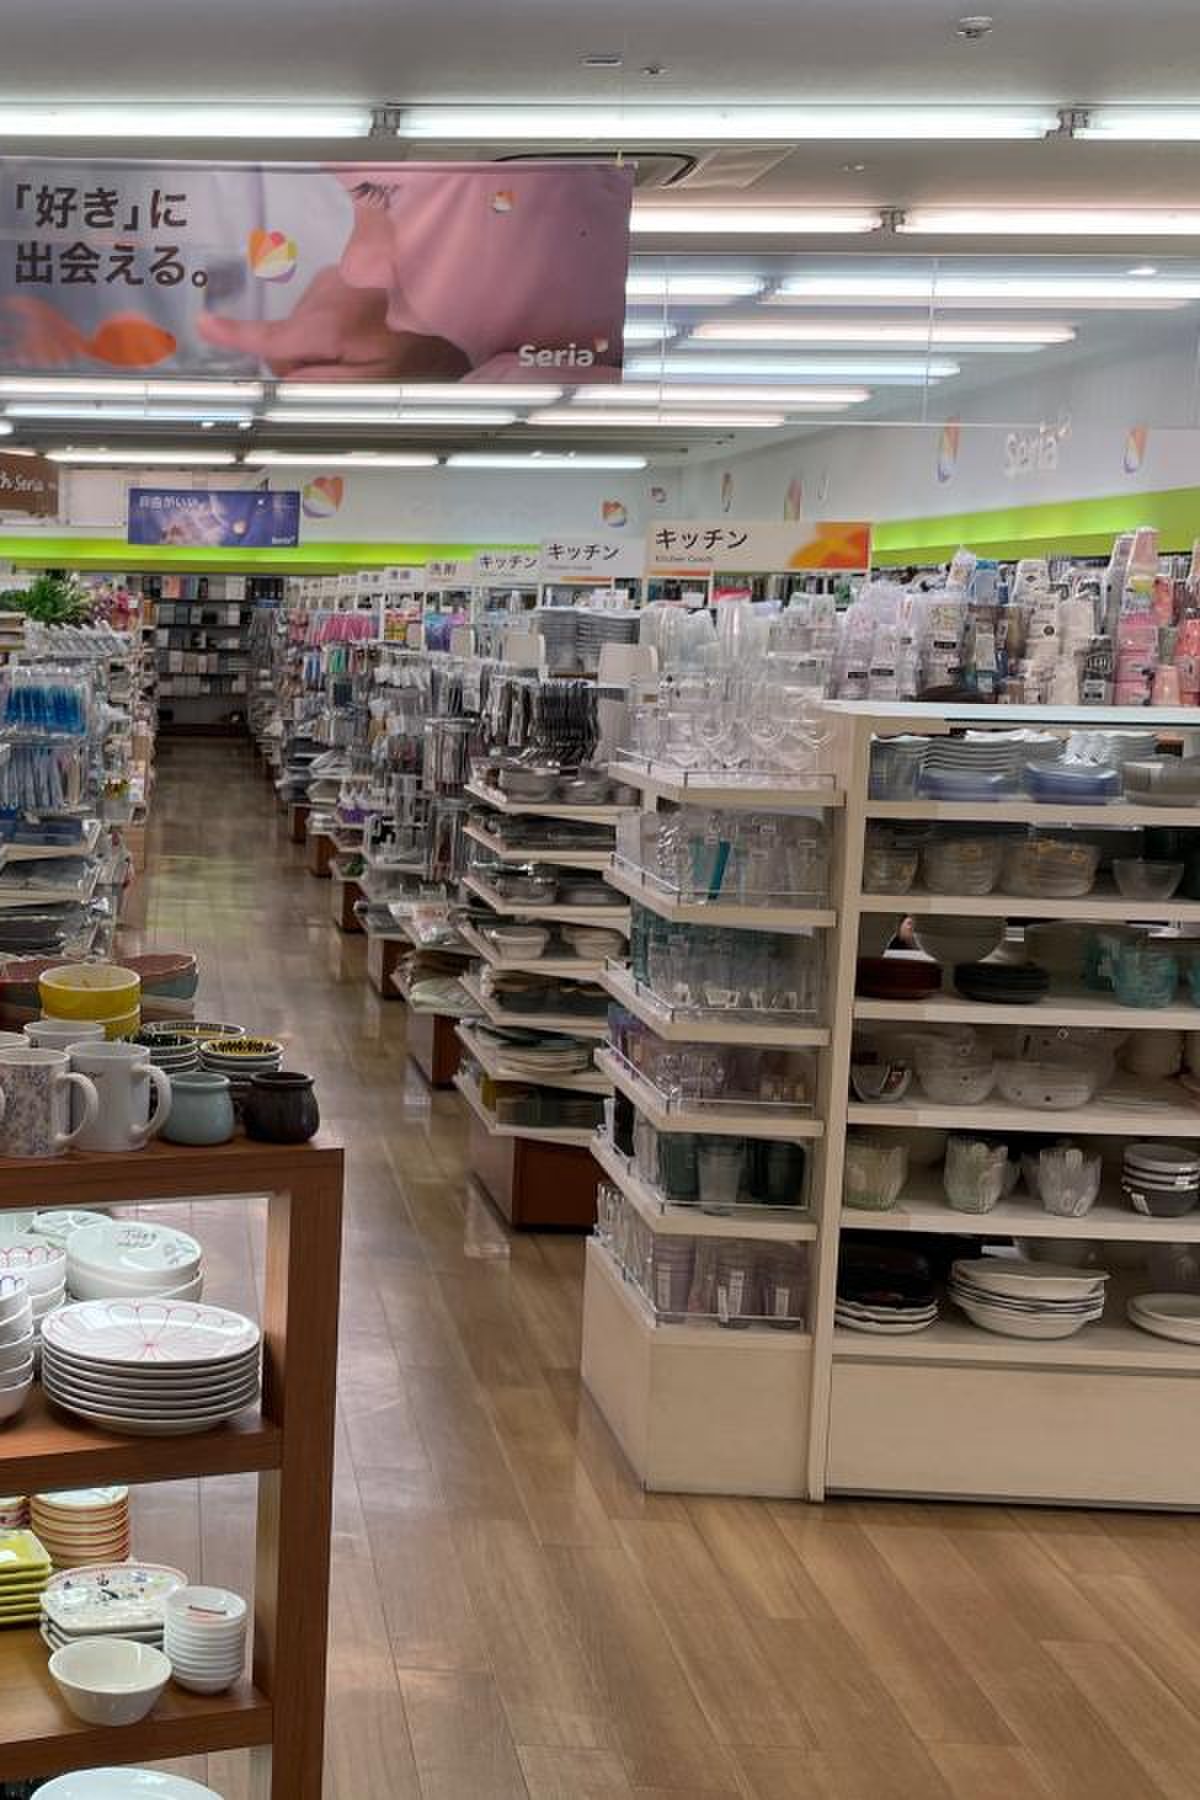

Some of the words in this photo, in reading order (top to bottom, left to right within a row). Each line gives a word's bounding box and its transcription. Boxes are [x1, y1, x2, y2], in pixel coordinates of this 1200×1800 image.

[16, 184, 187, 230] 「好き」に
[16, 241, 208, 287] 出会える。
[519, 343, 593, 367] Seria
[655, 528, 748, 550] キッチン
[480, 554, 538, 570] キッチン
[548, 543, 620, 561] キッチン
